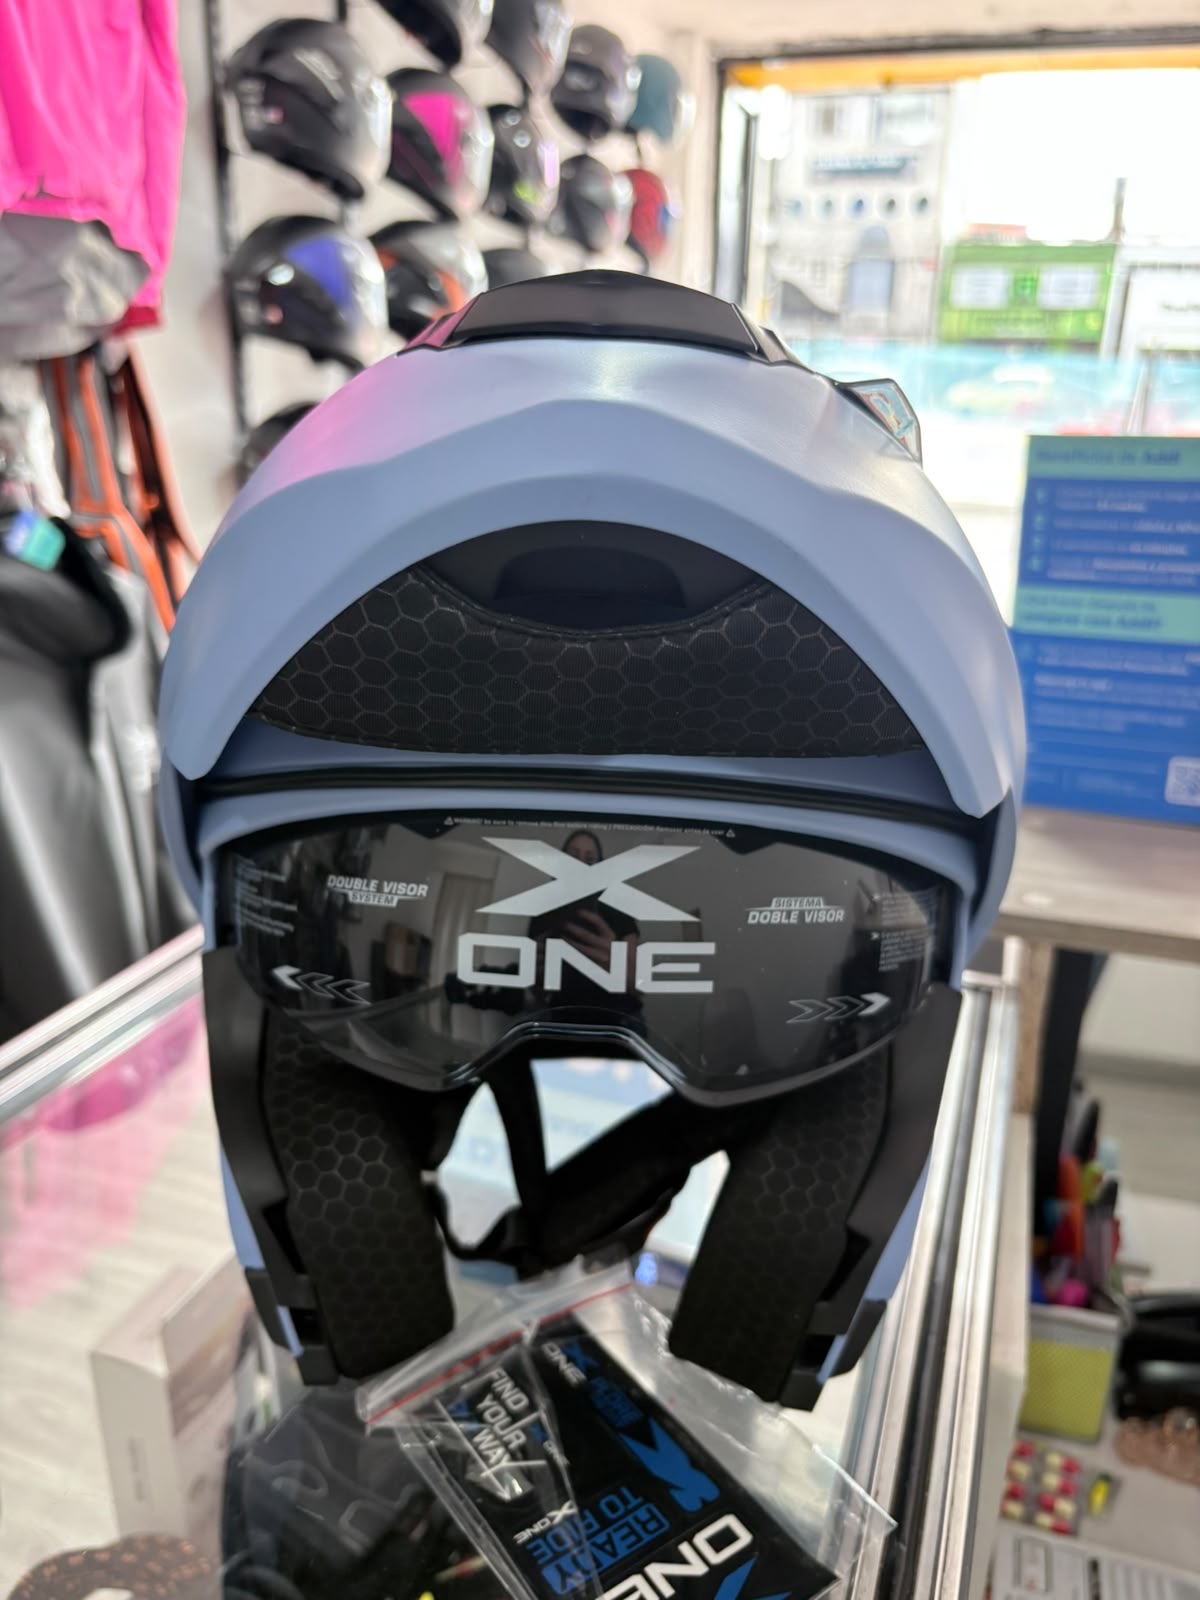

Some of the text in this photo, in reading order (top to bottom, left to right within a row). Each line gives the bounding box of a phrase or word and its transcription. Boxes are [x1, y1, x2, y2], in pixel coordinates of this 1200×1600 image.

[327, 875, 429, 897] DOUBLE VISOR
[475, 837, 701, 922] X
[350, 891, 397, 905] SYSTEM
[772, 897, 823, 909] SISTEMA
[747, 909, 845, 924] DOBLE VISOR
[457, 932, 716, 993] ONE
[488, 1368, 530, 1412] FIND
[475, 1393, 532, 1451] YOUR
[599, 1486, 643, 1521] TO
